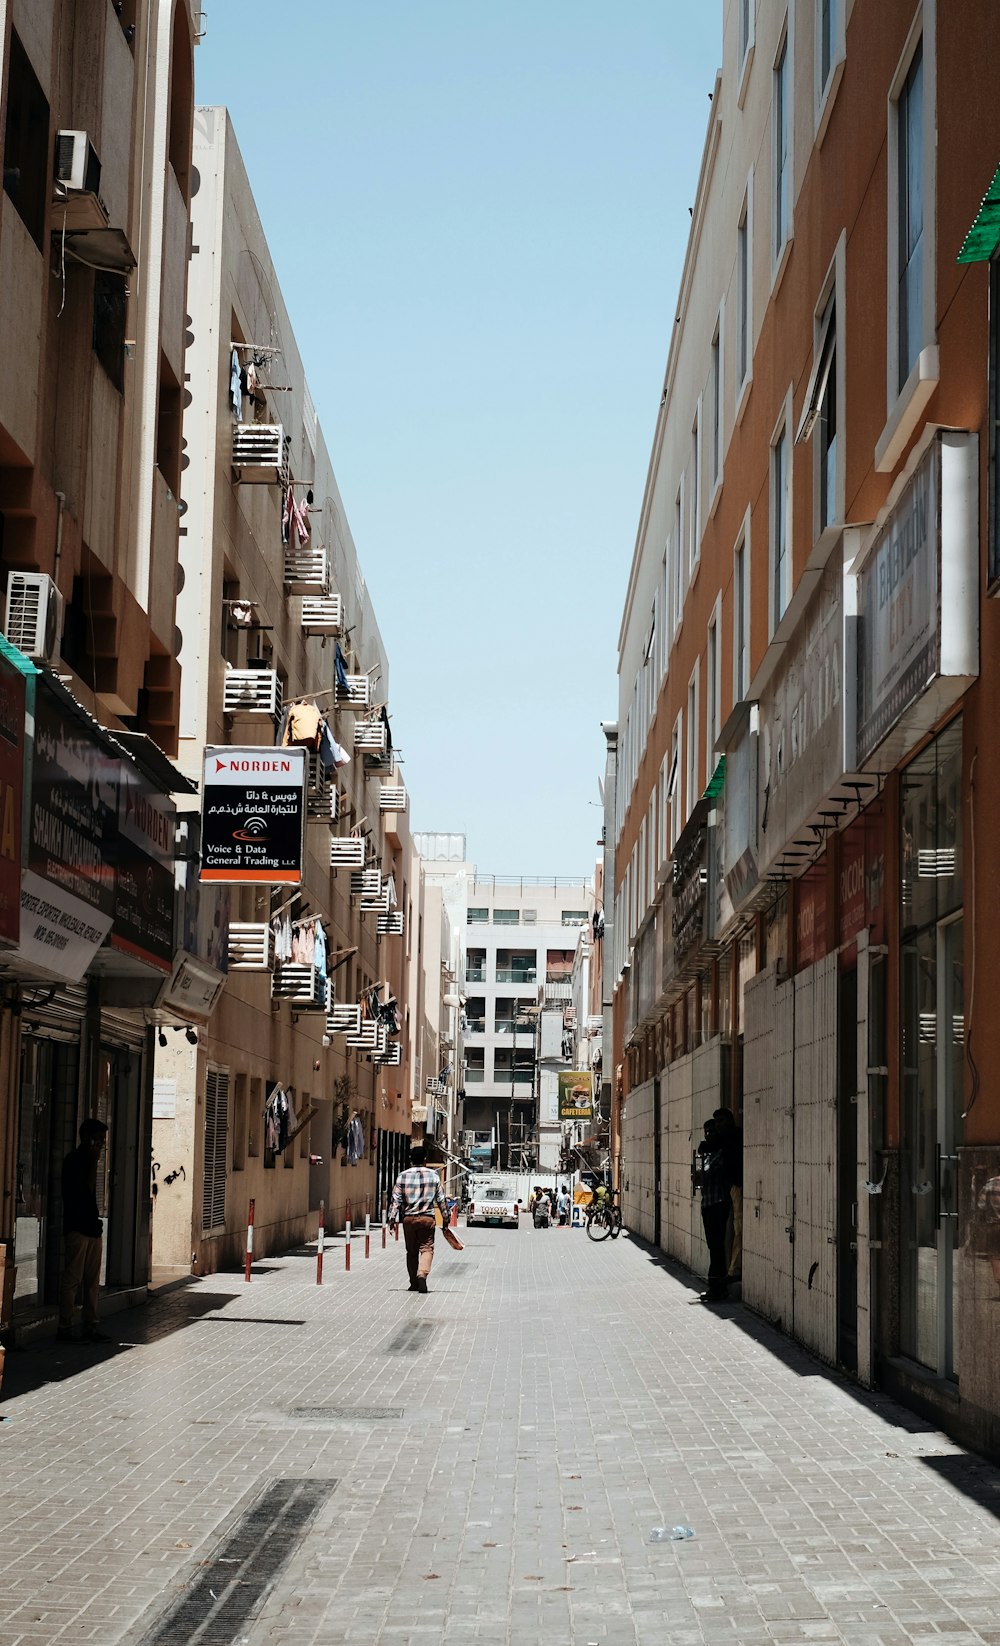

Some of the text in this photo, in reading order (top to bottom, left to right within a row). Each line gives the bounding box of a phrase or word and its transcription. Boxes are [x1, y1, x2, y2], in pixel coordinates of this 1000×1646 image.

[879, 489, 928, 610] BABYLON
[889, 573, 914, 654] CITY
[229, 760, 290, 772] NORDEN
[246, 790, 298, 803] فويس & داتا
[244, 804, 270, 814] العامة
[270, 804, 298, 816] للتجارة
[134, 791, 168, 851] NORDEN
[33, 803, 63, 859] SHAIKH
[207, 844, 267, 854] Voice & Data
[206, 855, 241, 865] General
[244, 855, 279, 867] Trading
[840, 854, 864, 906] RICOH
[561, 1108, 591, 1116] CAFETERIA
